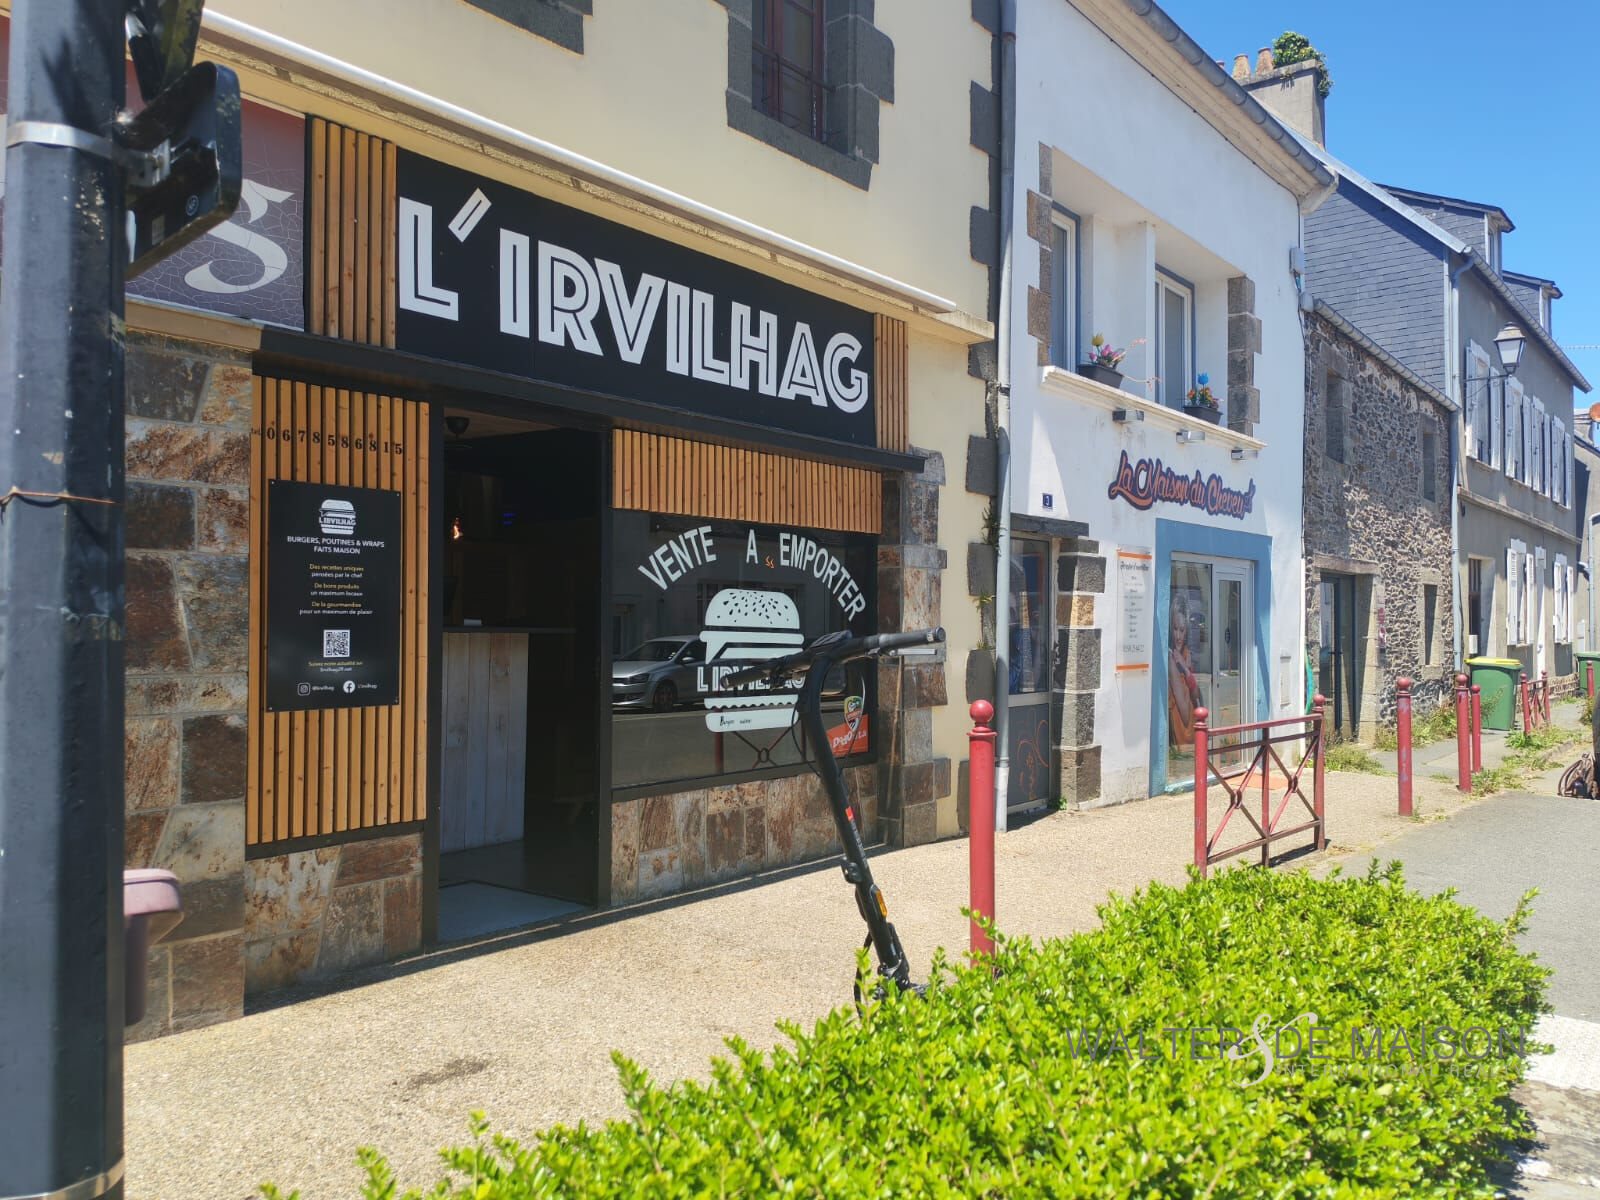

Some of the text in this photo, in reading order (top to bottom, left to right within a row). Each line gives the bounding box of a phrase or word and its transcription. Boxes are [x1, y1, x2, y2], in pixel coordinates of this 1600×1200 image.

[266, 427, 404, 455] 0678586815
[1109, 449, 1153, 511] La
[1190, 469, 1207, 511] du
[313, 545, 332, 553] FAITS
[321, 538, 355, 546] POUTINES
[362, 540, 385, 548] WRAPS
[638, 525, 866, 622] VENTE A EMPORTER
